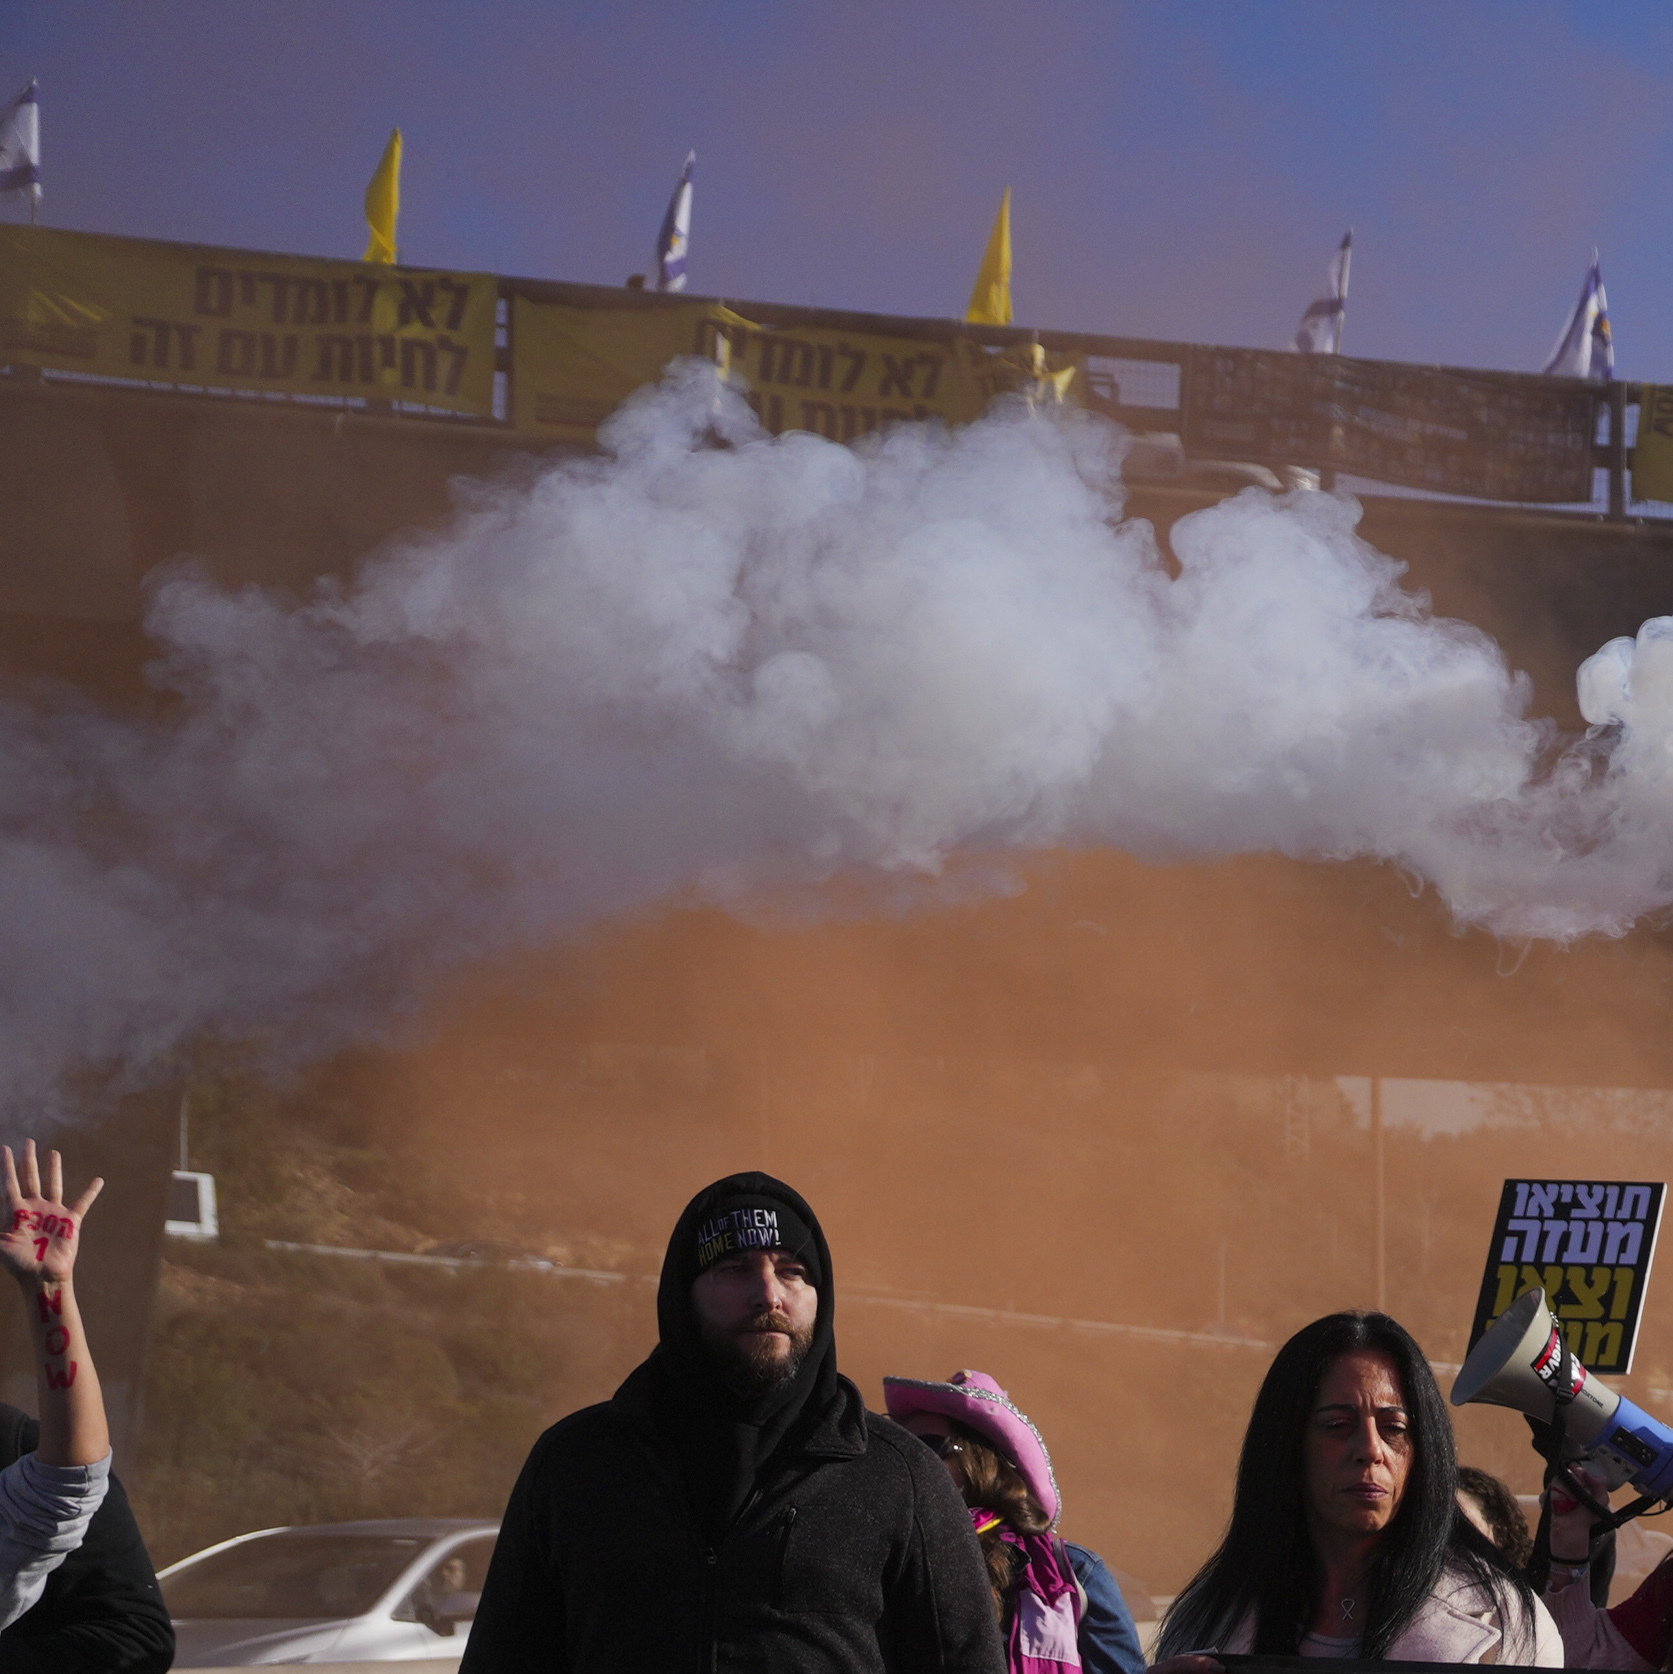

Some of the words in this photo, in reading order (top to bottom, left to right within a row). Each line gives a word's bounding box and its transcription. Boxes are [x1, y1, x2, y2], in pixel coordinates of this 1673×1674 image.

[397, 275, 470, 331] לא
[128, 315, 200, 371] זה
[215, 328, 299, 380] עם
[877, 342, 944, 399] לא
[717, 1215, 729, 1232] OF
[730, 1208, 778, 1229] THEM
[1513, 1183, 1652, 1220] תוציאו
[698, 1231, 736, 1268] HOME
[736, 1227, 782, 1249] NOW!
[1500, 1218, 1645, 1265] מעזה
[37, 1289, 78, 1391] NOW
